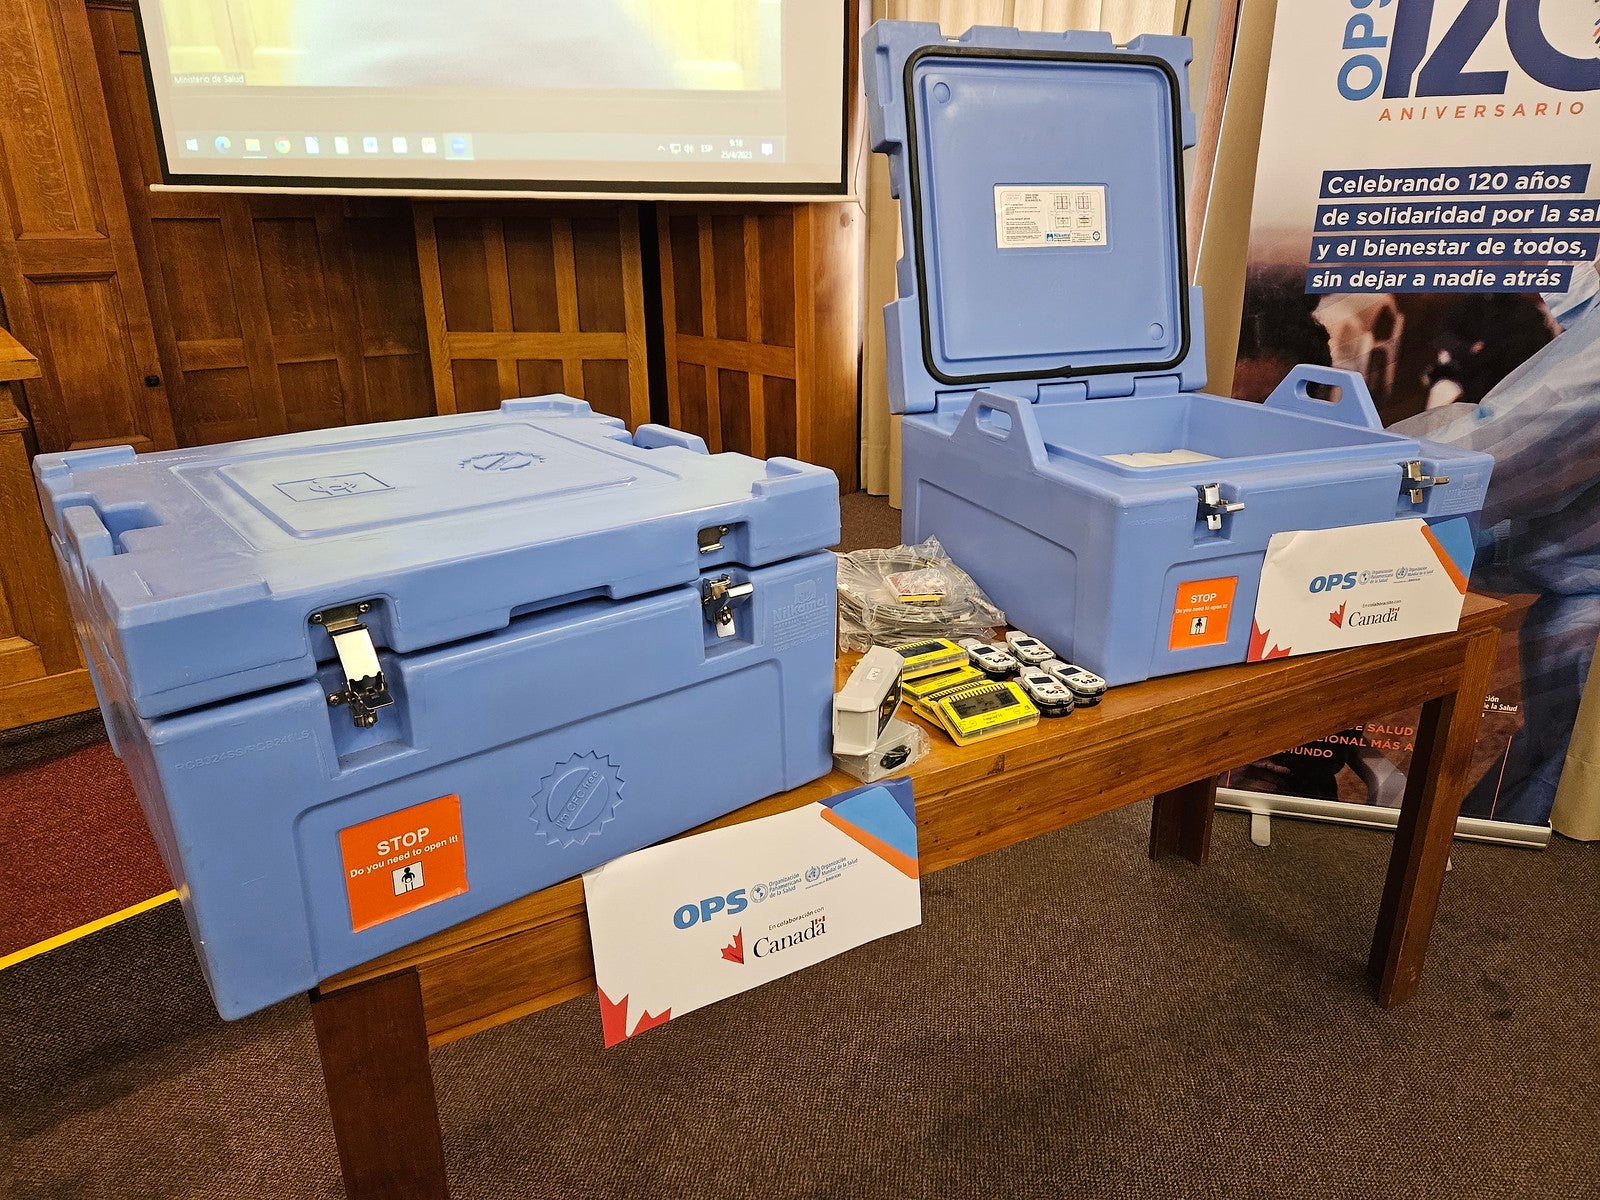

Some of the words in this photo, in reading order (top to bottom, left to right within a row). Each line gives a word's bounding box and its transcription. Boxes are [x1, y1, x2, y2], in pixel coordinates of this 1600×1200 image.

[1337, 0, 1392, 101] OP
[211, 75, 221, 84] de
[223, 75, 244, 84] Salud
[1378, 101, 1585, 122] ANIVERSARIO
[1327, 174, 1460, 194] Celebrando
[1468, 173, 1508, 190] 120
[1515, 171, 1572, 190] años
[1322, 209, 1350, 226] de
[1356, 206, 1486, 225] solidaridad
[1491, 208, 1534, 227] por
[1541, 205, 1561, 223] la
[1317, 243, 1331, 260] y
[1337, 240, 1357, 257] el
[1363, 238, 1470, 256] bienestar
[1476, 238, 1506, 255] de
[1513, 237, 1588, 257] todos,
[1312, 272, 1342, 288] sin
[1349, 270, 1407, 290] dejar
[1412, 273, 1426, 287] a
[1433, 269, 1496, 287] nadie
[1503, 268, 1562, 287] atrás
[1309, 571, 1358, 593] OPS
[1190, 593, 1217, 604] STOP
[1499, 703, 1518, 712] Salud
[1367, 723, 1414, 736] SALUD
[1316, 735, 1367, 747] IONAL
[1371, 738, 1401, 751] MÁS
[566, 789, 585, 812] CFC
[582, 770, 599, 790] free
[377, 827, 430, 856] STOP
[349, 868, 365, 878] Do
[366, 860, 385, 874] you
[387, 851, 411, 865] need
[412, 848, 422, 857] to
[424, 840, 448, 853] open
[449, 834, 459, 844] it!
[820, 857, 847, 870] Organización
[847, 858, 859, 866] Salud
[768, 873, 800, 887] Organización
[768, 877, 802, 893] Panamericana
[769, 891, 776, 899] de
[782, 885, 796, 895] Salud
[673, 889, 749, 930] OPS
[768, 923, 777, 931] En
[777, 911, 814, 928] colaboración
[814, 906, 825, 914] con
